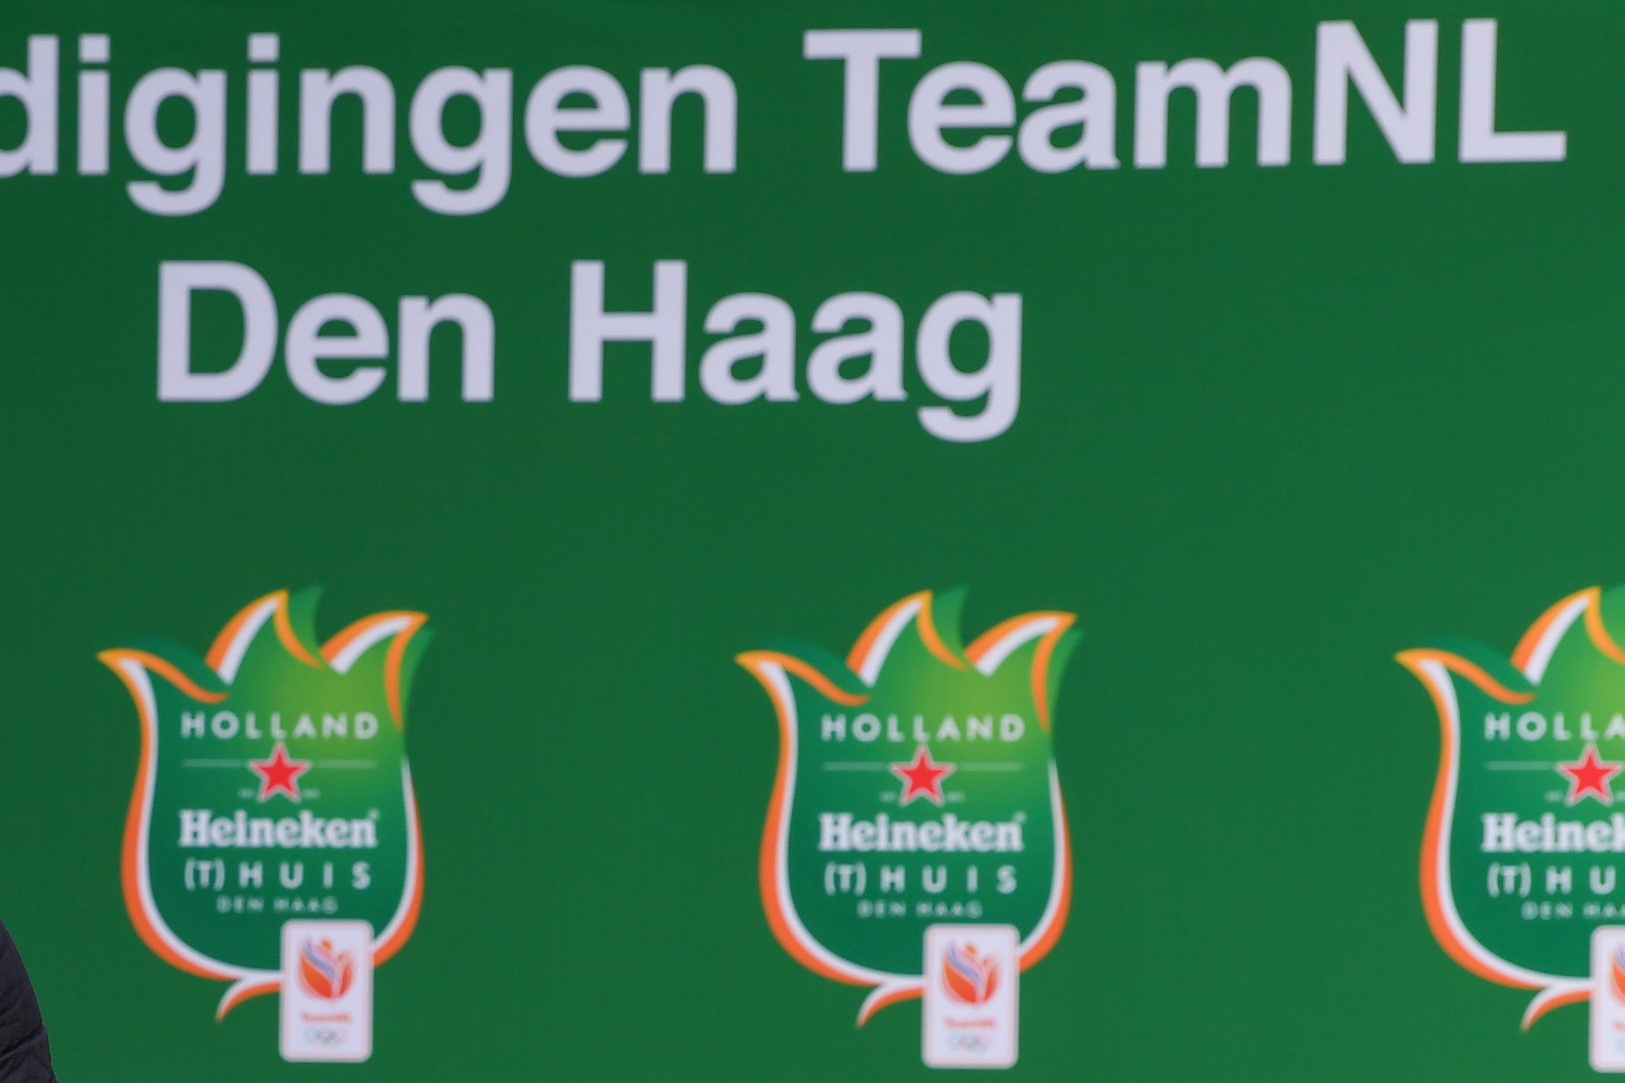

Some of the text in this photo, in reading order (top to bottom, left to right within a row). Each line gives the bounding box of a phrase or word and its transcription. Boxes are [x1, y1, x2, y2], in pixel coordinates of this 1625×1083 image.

[803, 17, 1568, 174] TeamNL
[157, 259, 1023, 443] Den Haag
[181, 710, 379, 740] HOLLAND
[821, 713, 1026, 742] HOLLAND
[1485, 711, 1625, 741] HOLLA
[178, 809, 379, 849] Heineken
[818, 812, 1025, 853] Heineken
[1481, 812, 1625, 853] Heine
